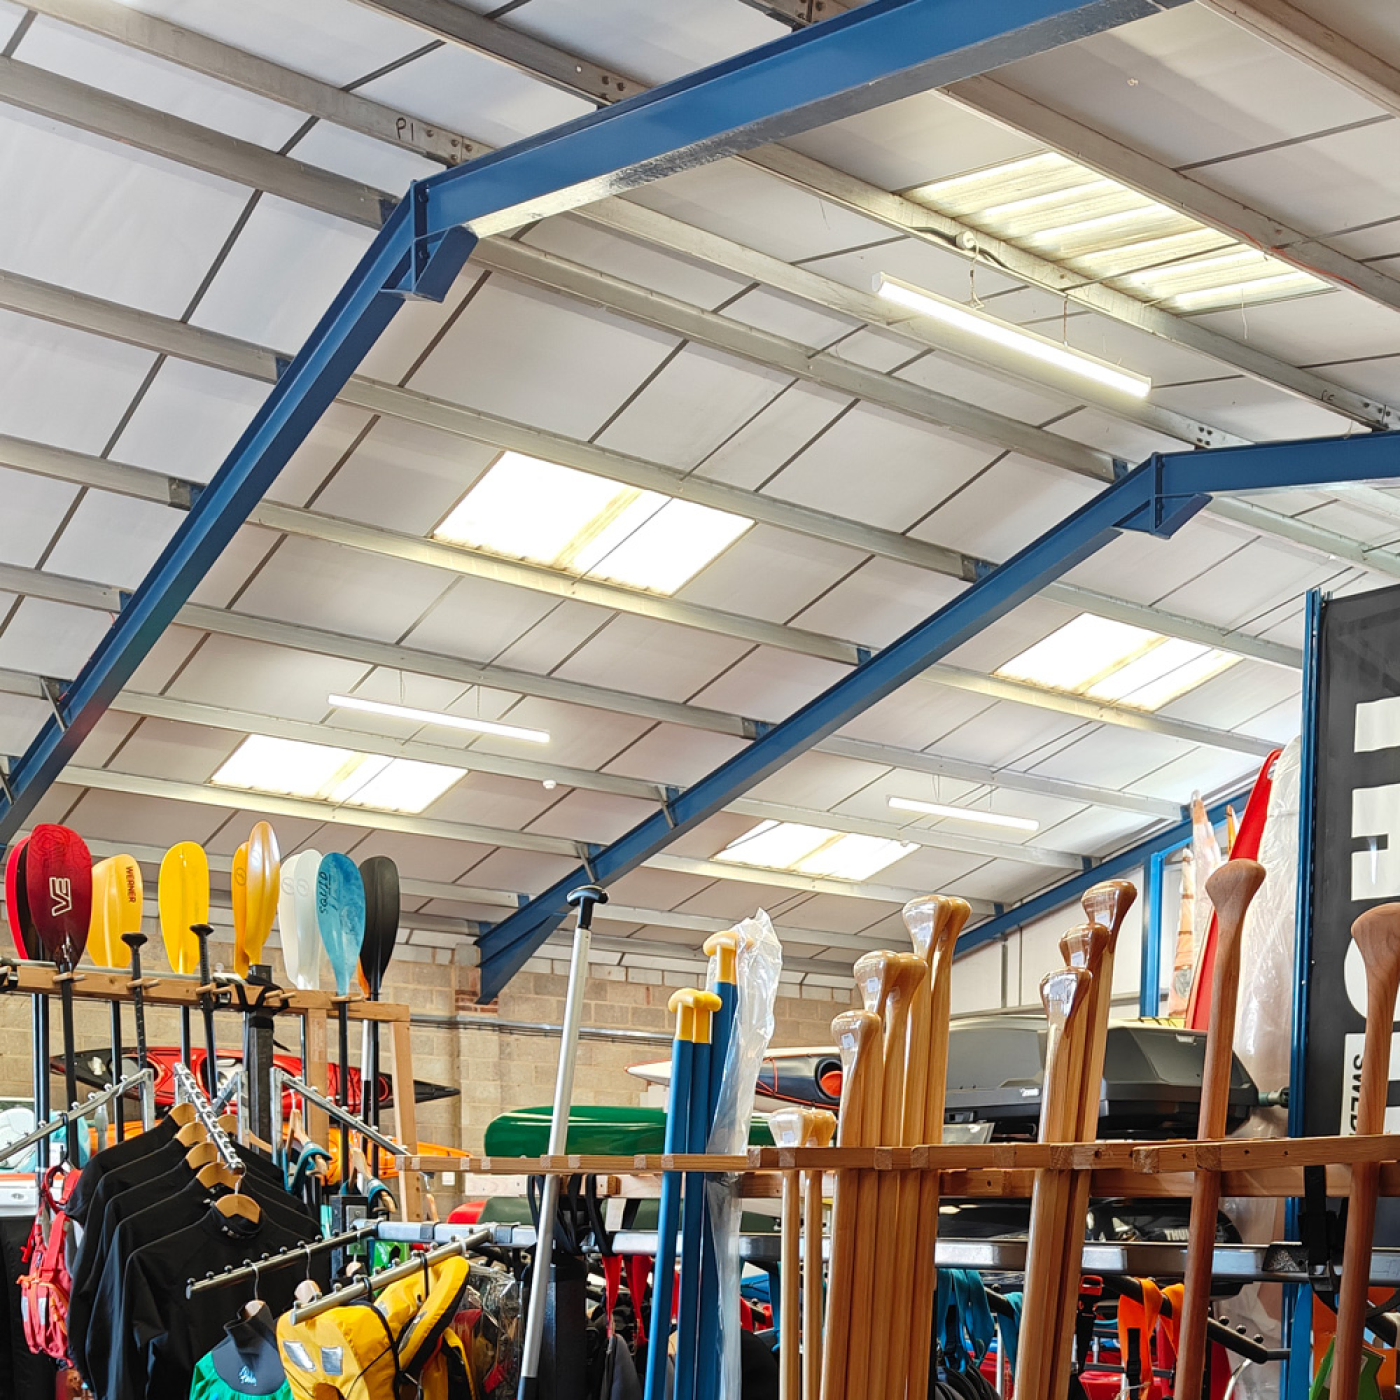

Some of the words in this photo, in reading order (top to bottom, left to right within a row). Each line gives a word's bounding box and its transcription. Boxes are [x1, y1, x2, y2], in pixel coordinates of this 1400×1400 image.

[48, 876, 73, 917] VE
[125, 865, 136, 903] WERNER
[1349, 1053, 1363, 1136] SWED
[1163, 1227, 1190, 1241] THU
